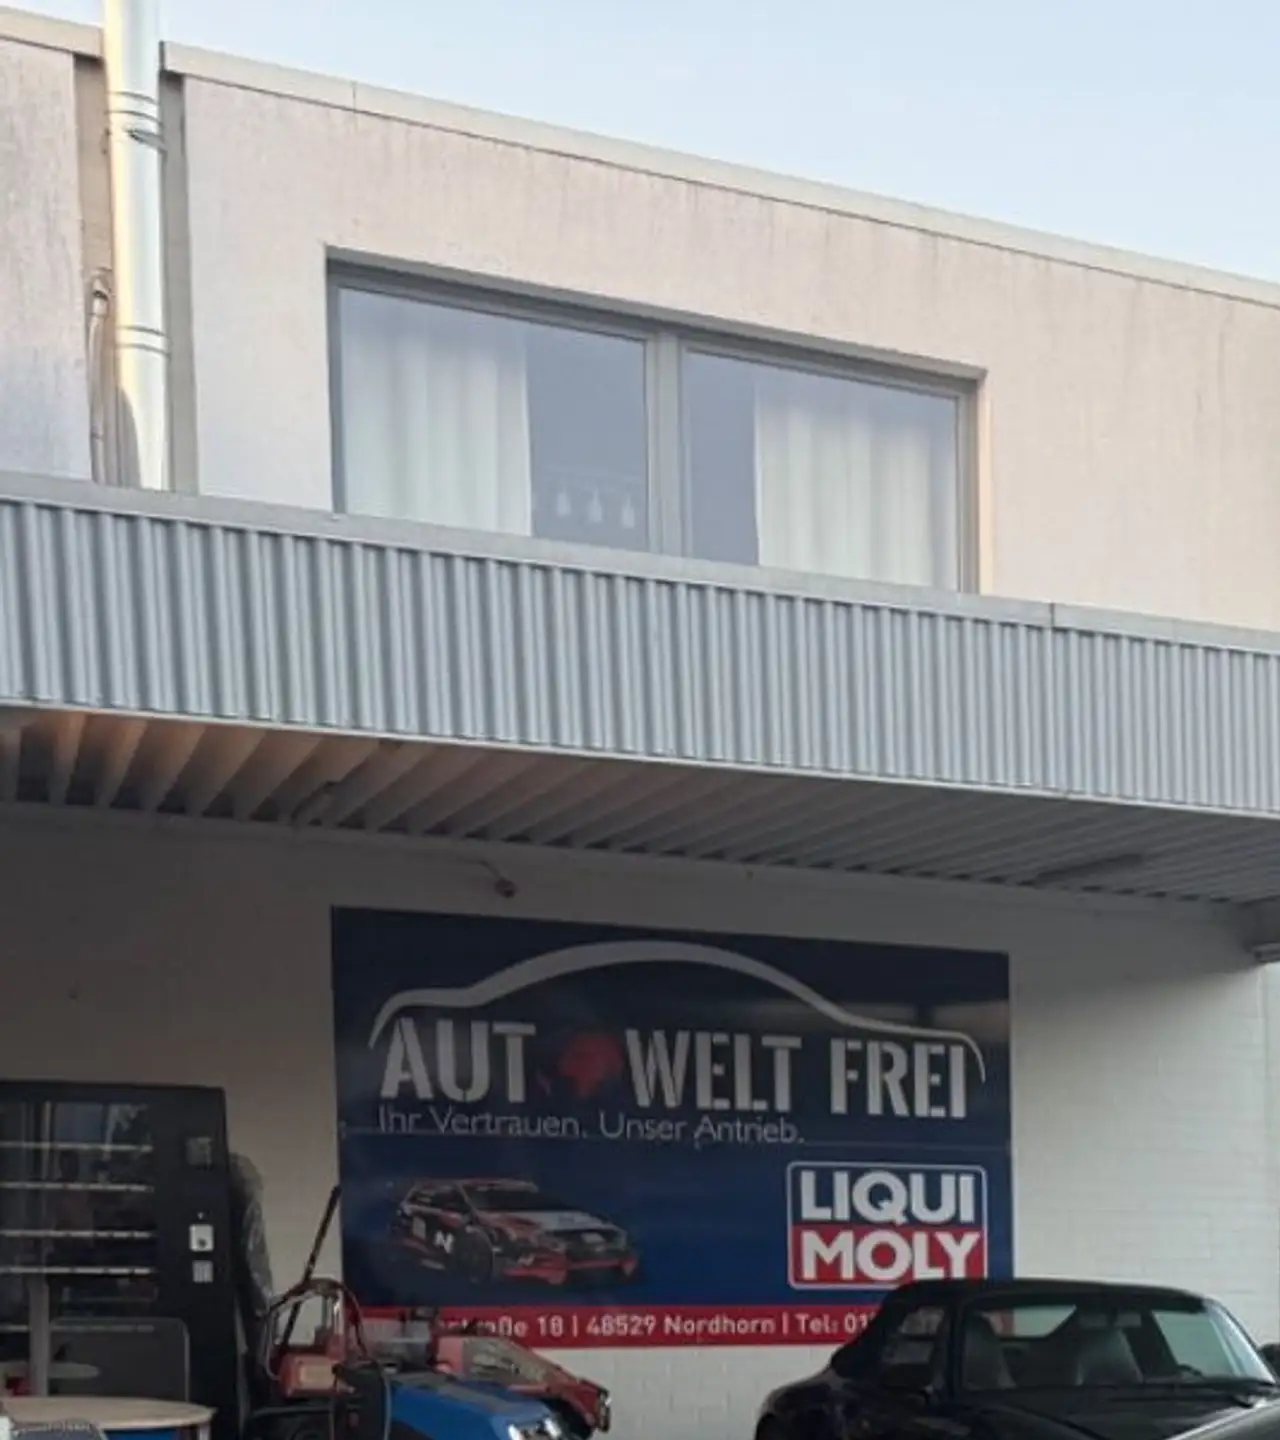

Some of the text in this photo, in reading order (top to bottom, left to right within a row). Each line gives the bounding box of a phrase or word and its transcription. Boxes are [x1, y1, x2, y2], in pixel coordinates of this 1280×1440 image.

[624, 1029, 801, 1113] WELT
[830, 1037, 967, 1119] FREI
[378, 1105, 805, 1146] Ihr Vertrauen. Unser Antrieb.
[801, 1170, 975, 1225] LIQUI
[801, 1229, 980, 1281] MOLY
[587, 1314, 657, 1336] 48529
[664, 1314, 775, 1335] Nordhorn
[795, 1314, 838, 1335] Tel:
[844, 1313, 876, 1333] 01
